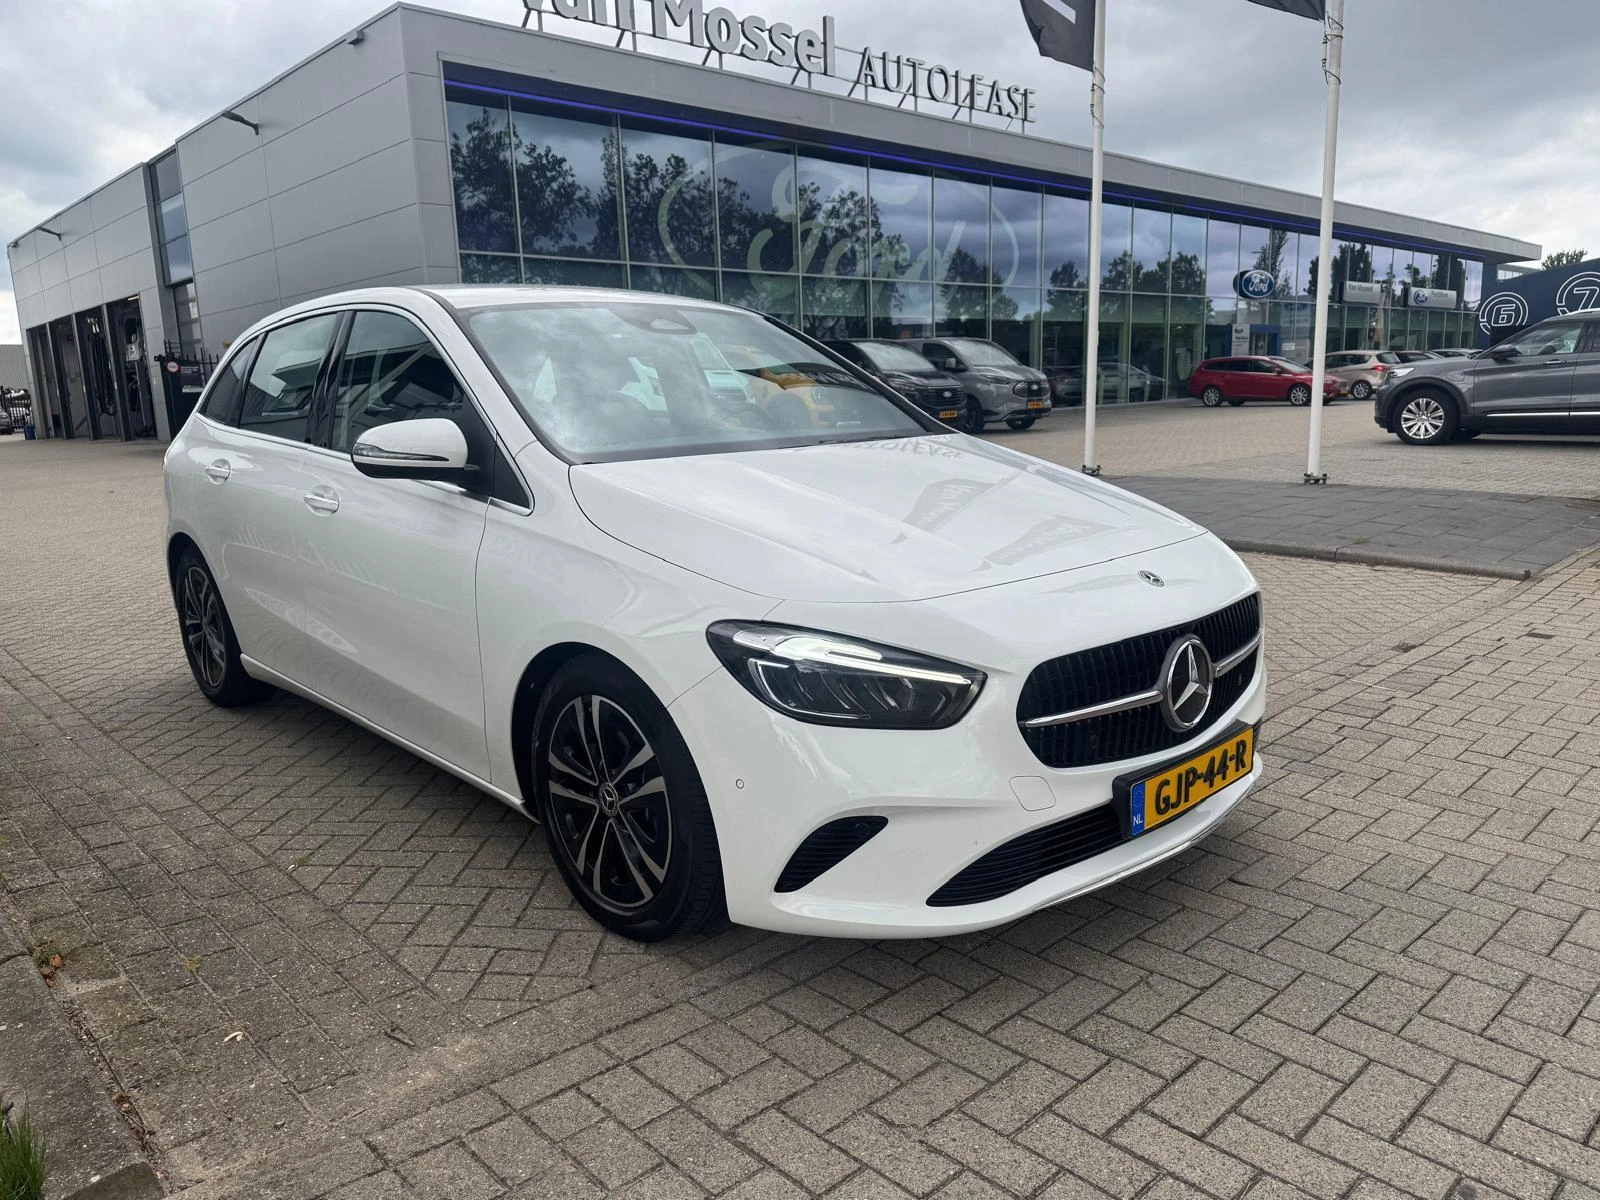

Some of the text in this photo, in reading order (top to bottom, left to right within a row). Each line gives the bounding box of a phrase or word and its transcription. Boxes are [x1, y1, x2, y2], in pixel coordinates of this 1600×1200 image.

[651, 0, 1036, 123] Mossel AUTOLEASE
[747, 164, 966, 302] Ford
[1248, 273, 1270, 292] Ford
[1491, 304, 1516, 327] 6
[1155, 739, 1247, 816] GJP-44-R
[1133, 813, 1144, 827] NL
